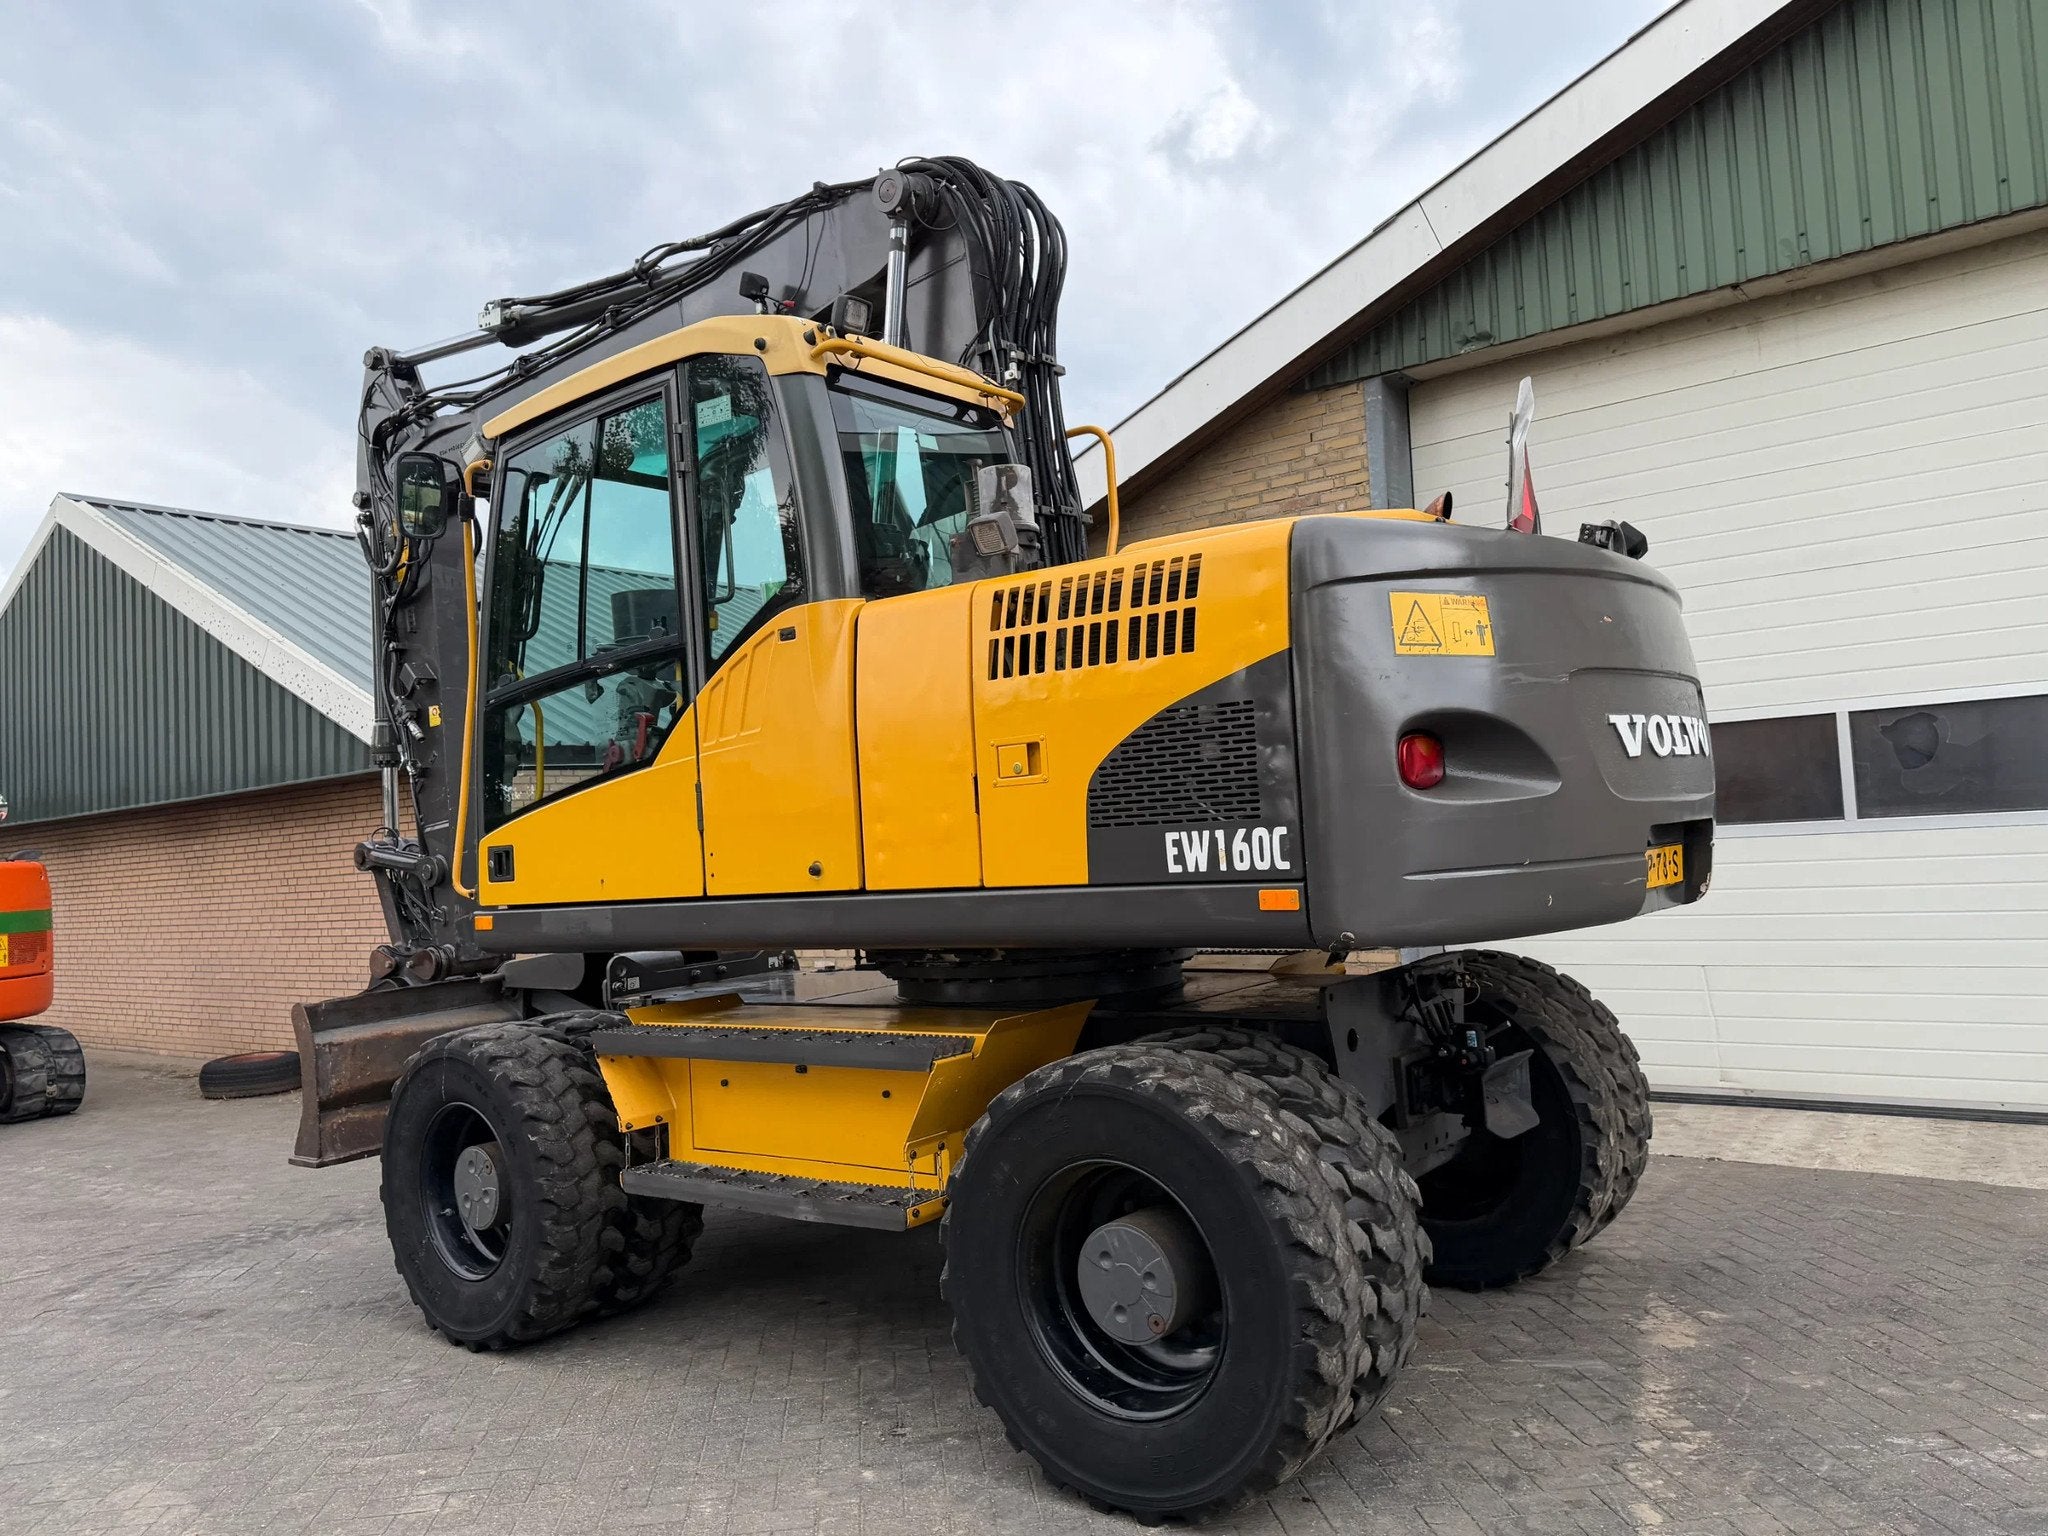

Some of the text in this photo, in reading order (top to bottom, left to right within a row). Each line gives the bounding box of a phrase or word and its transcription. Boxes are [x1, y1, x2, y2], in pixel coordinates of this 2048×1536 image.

[1451, 598, 1485, 608] WARN
[1608, 714, 1710, 757] VOLVO
[1165, 826, 1291, 873] EW160C
